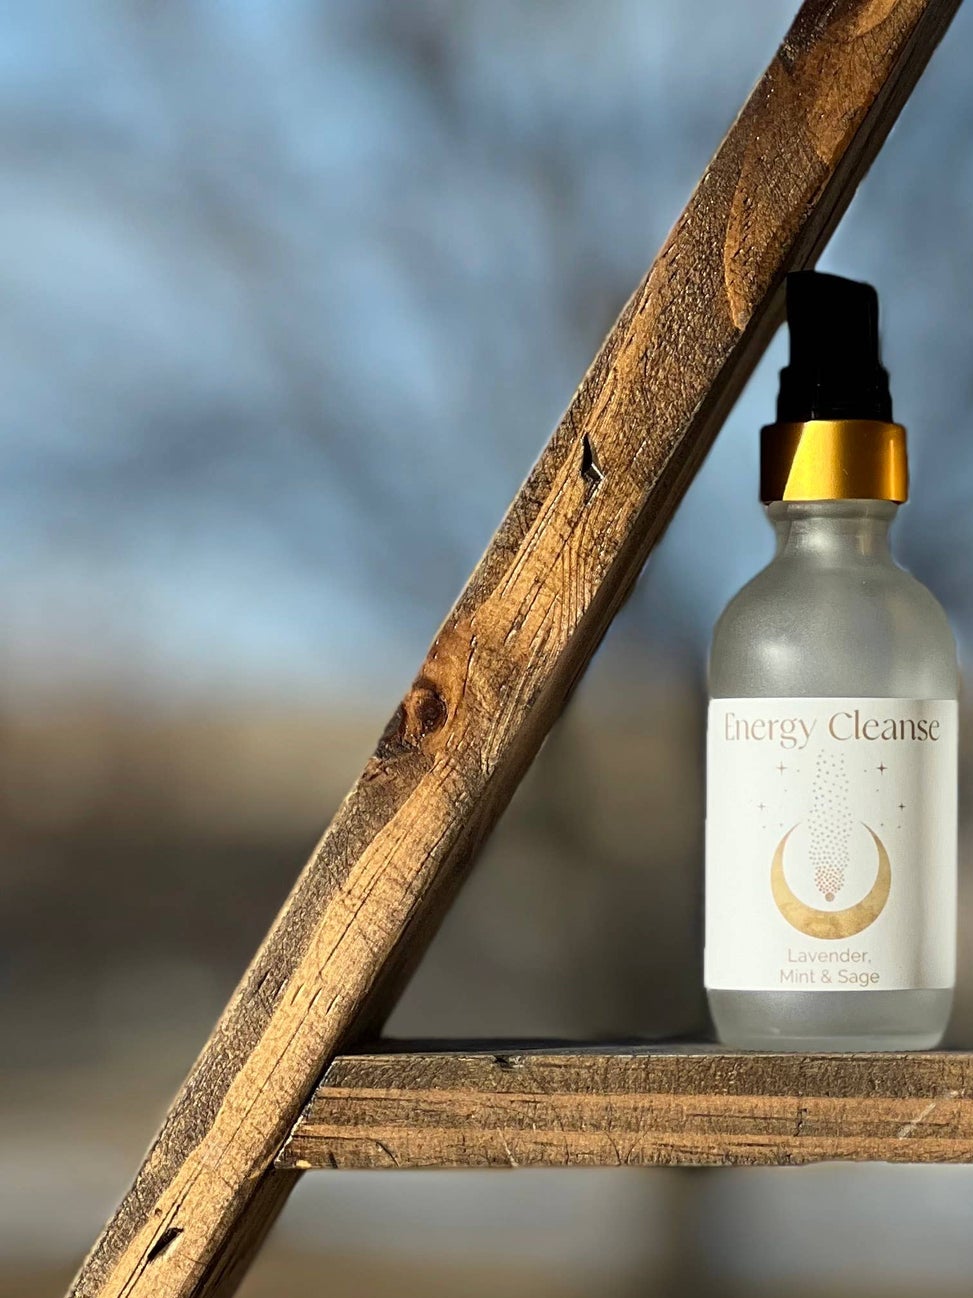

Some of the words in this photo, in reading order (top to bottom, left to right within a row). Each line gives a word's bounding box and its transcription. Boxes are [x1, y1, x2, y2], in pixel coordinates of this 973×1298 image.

[725, 712, 817, 749] Energy
[828, 710, 941, 741] Cleanse
[788, 949, 872, 963] Lavender,
[780, 969, 815, 984] Mint
[821, 970, 832, 984] &
[839, 970, 880, 987] Sage
